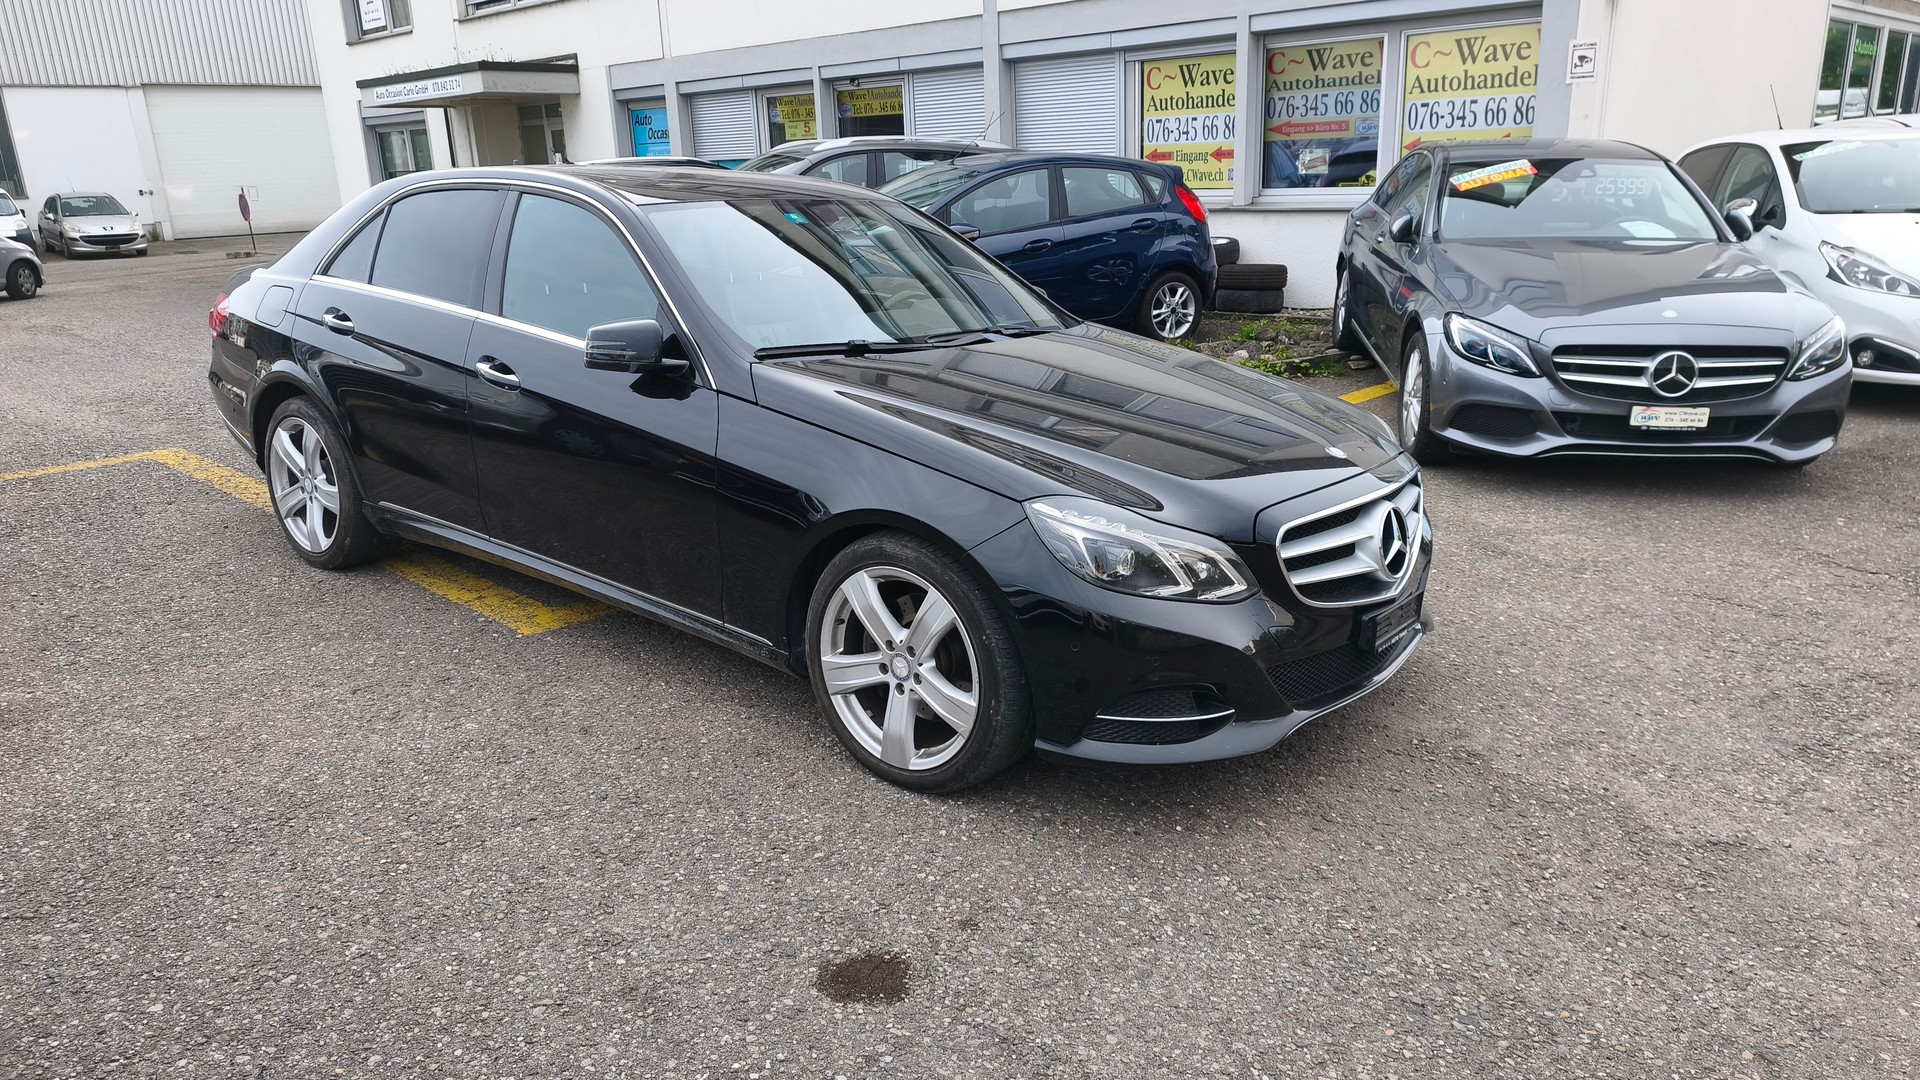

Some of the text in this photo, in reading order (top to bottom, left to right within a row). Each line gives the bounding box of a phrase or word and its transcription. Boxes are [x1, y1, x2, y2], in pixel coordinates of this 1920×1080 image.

[1268, 70, 1382, 92] Autohandel
[1409, 64, 1539, 95] Autohandel
[376, 91, 385, 100] Auto
[385, 89, 403, 99] Occasion
[415, 83, 429, 95] GmbH
[863, 102, 873, 114] 076
[879, 101, 888, 113] 345
[889, 101, 897, 111] 66
[1267, 89, 1380, 120] 076-345 66 86
[1408, 95, 1536, 131] 076-345 66 86
[635, 113, 652, 126] Auto
[803, 121, 811, 134] 5
[1315, 123, 1330, 131] Büro
[1147, 116, 1198, 143] 076-345
[1202, 115, 1219, 141] 66
[1175, 149, 1209, 164] Eingang
[1183, 167, 1224, 182] .CWave.ch
[1460, 166, 1533, 191] AUTOMAT
